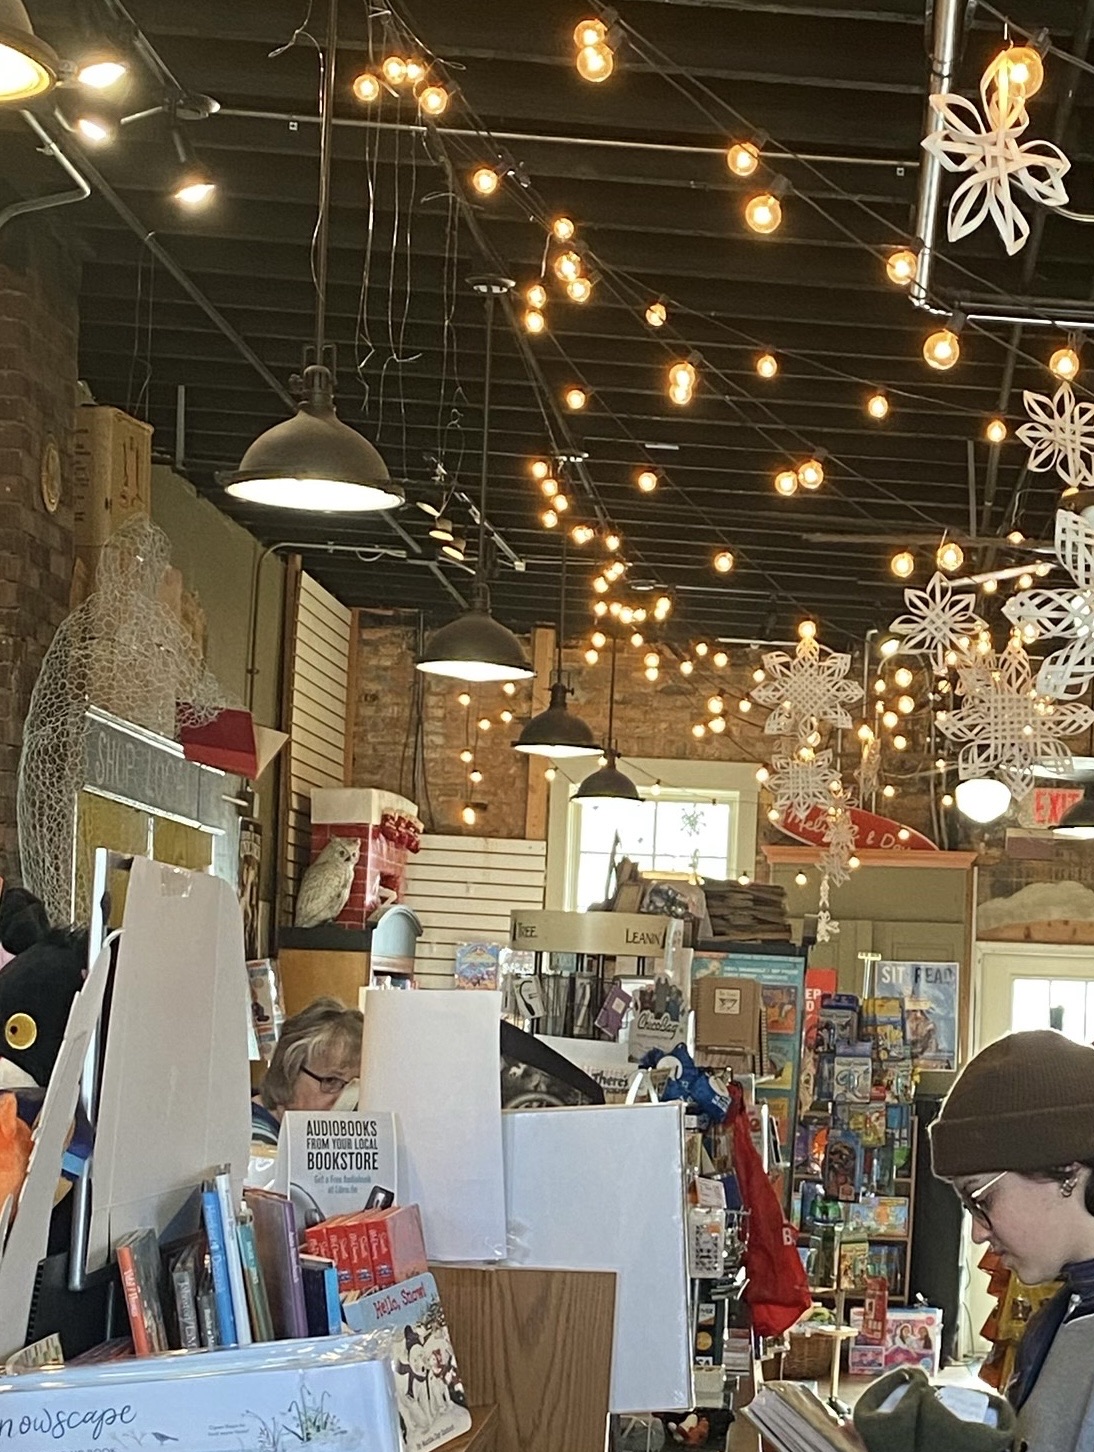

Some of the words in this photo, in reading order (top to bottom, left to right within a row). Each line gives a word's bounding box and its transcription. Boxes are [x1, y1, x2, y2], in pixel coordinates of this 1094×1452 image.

[881, 966, 906, 984] SIT
[306, 1120, 378, 1137] AUDIOBOOKS
[306, 1138, 330, 1150] FROM
[333, 1138, 353, 1150] YOUR
[354, 1138, 378, 1150] LOCAL
[307, 1151, 379, 1171] BOOKSTORE
[373, 1295, 401, 1320] Hello,
